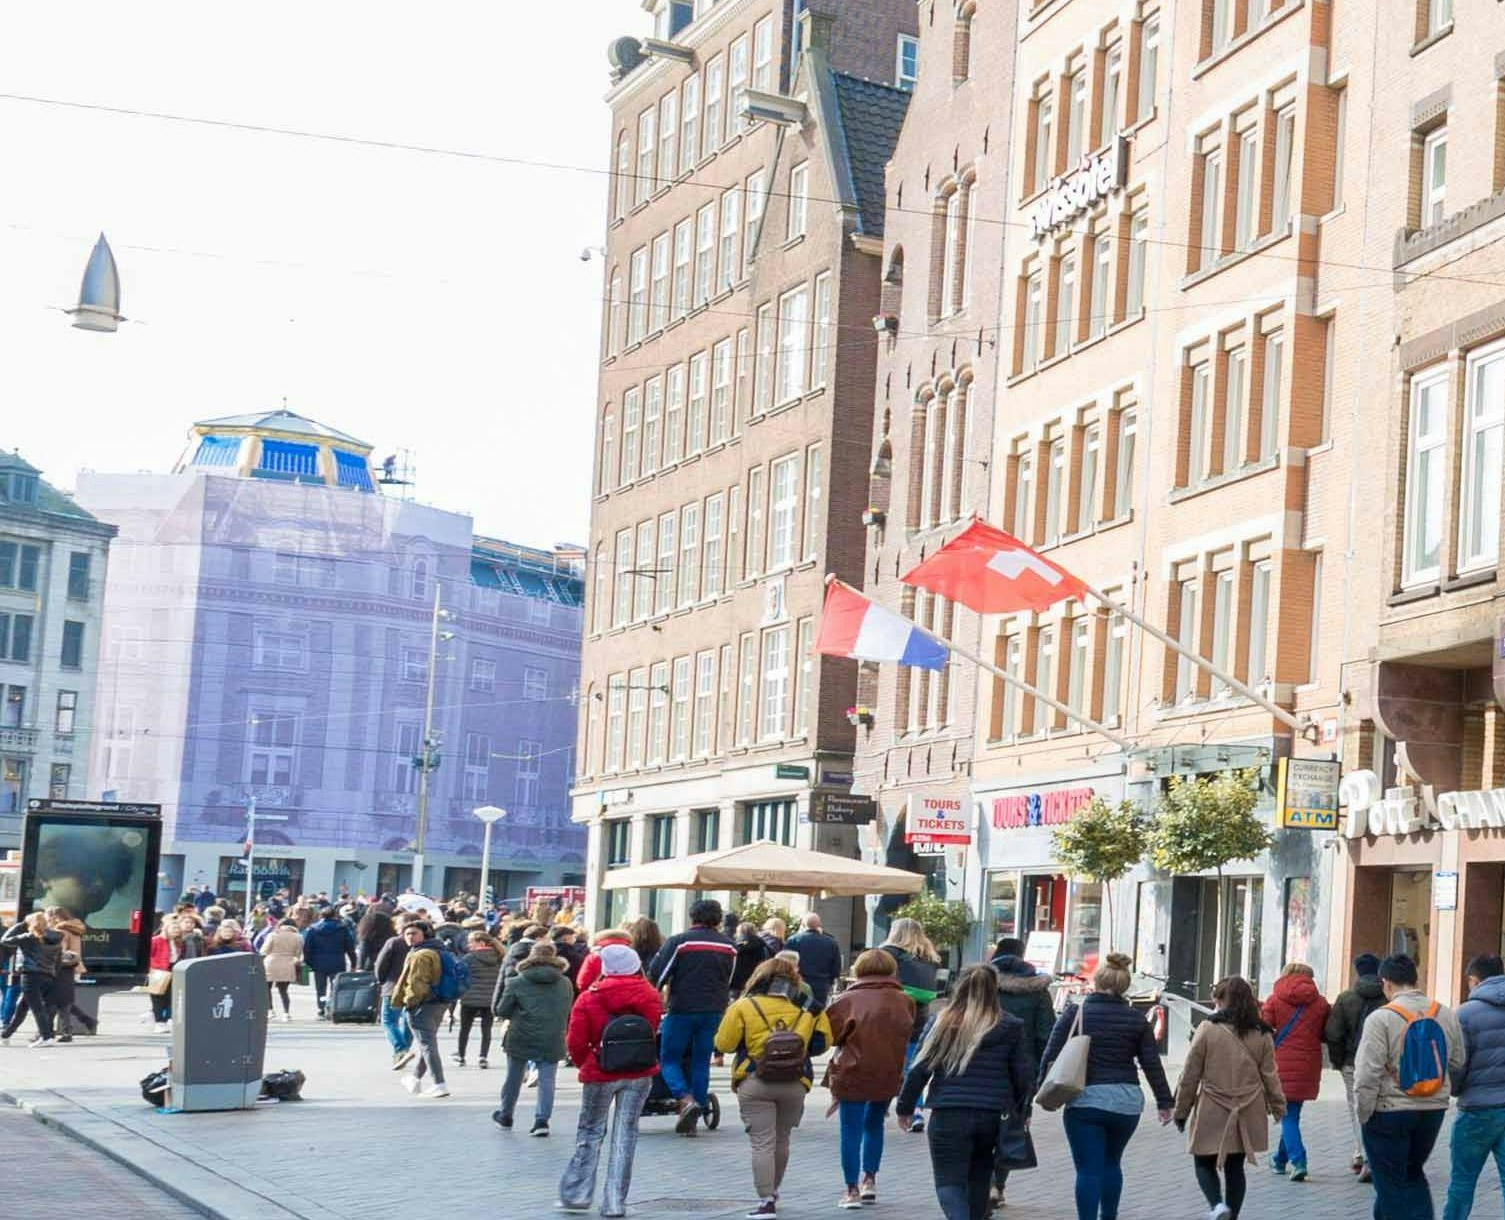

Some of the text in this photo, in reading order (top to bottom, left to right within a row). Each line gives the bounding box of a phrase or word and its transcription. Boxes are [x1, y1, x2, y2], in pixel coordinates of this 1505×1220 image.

[923, 799, 961, 810] TOURS
[936, 810, 945, 819] &
[1290, 811, 1334, 824] ATM
[918, 819, 965, 830] TICKETS
[229, 861, 290, 876] Raobank
